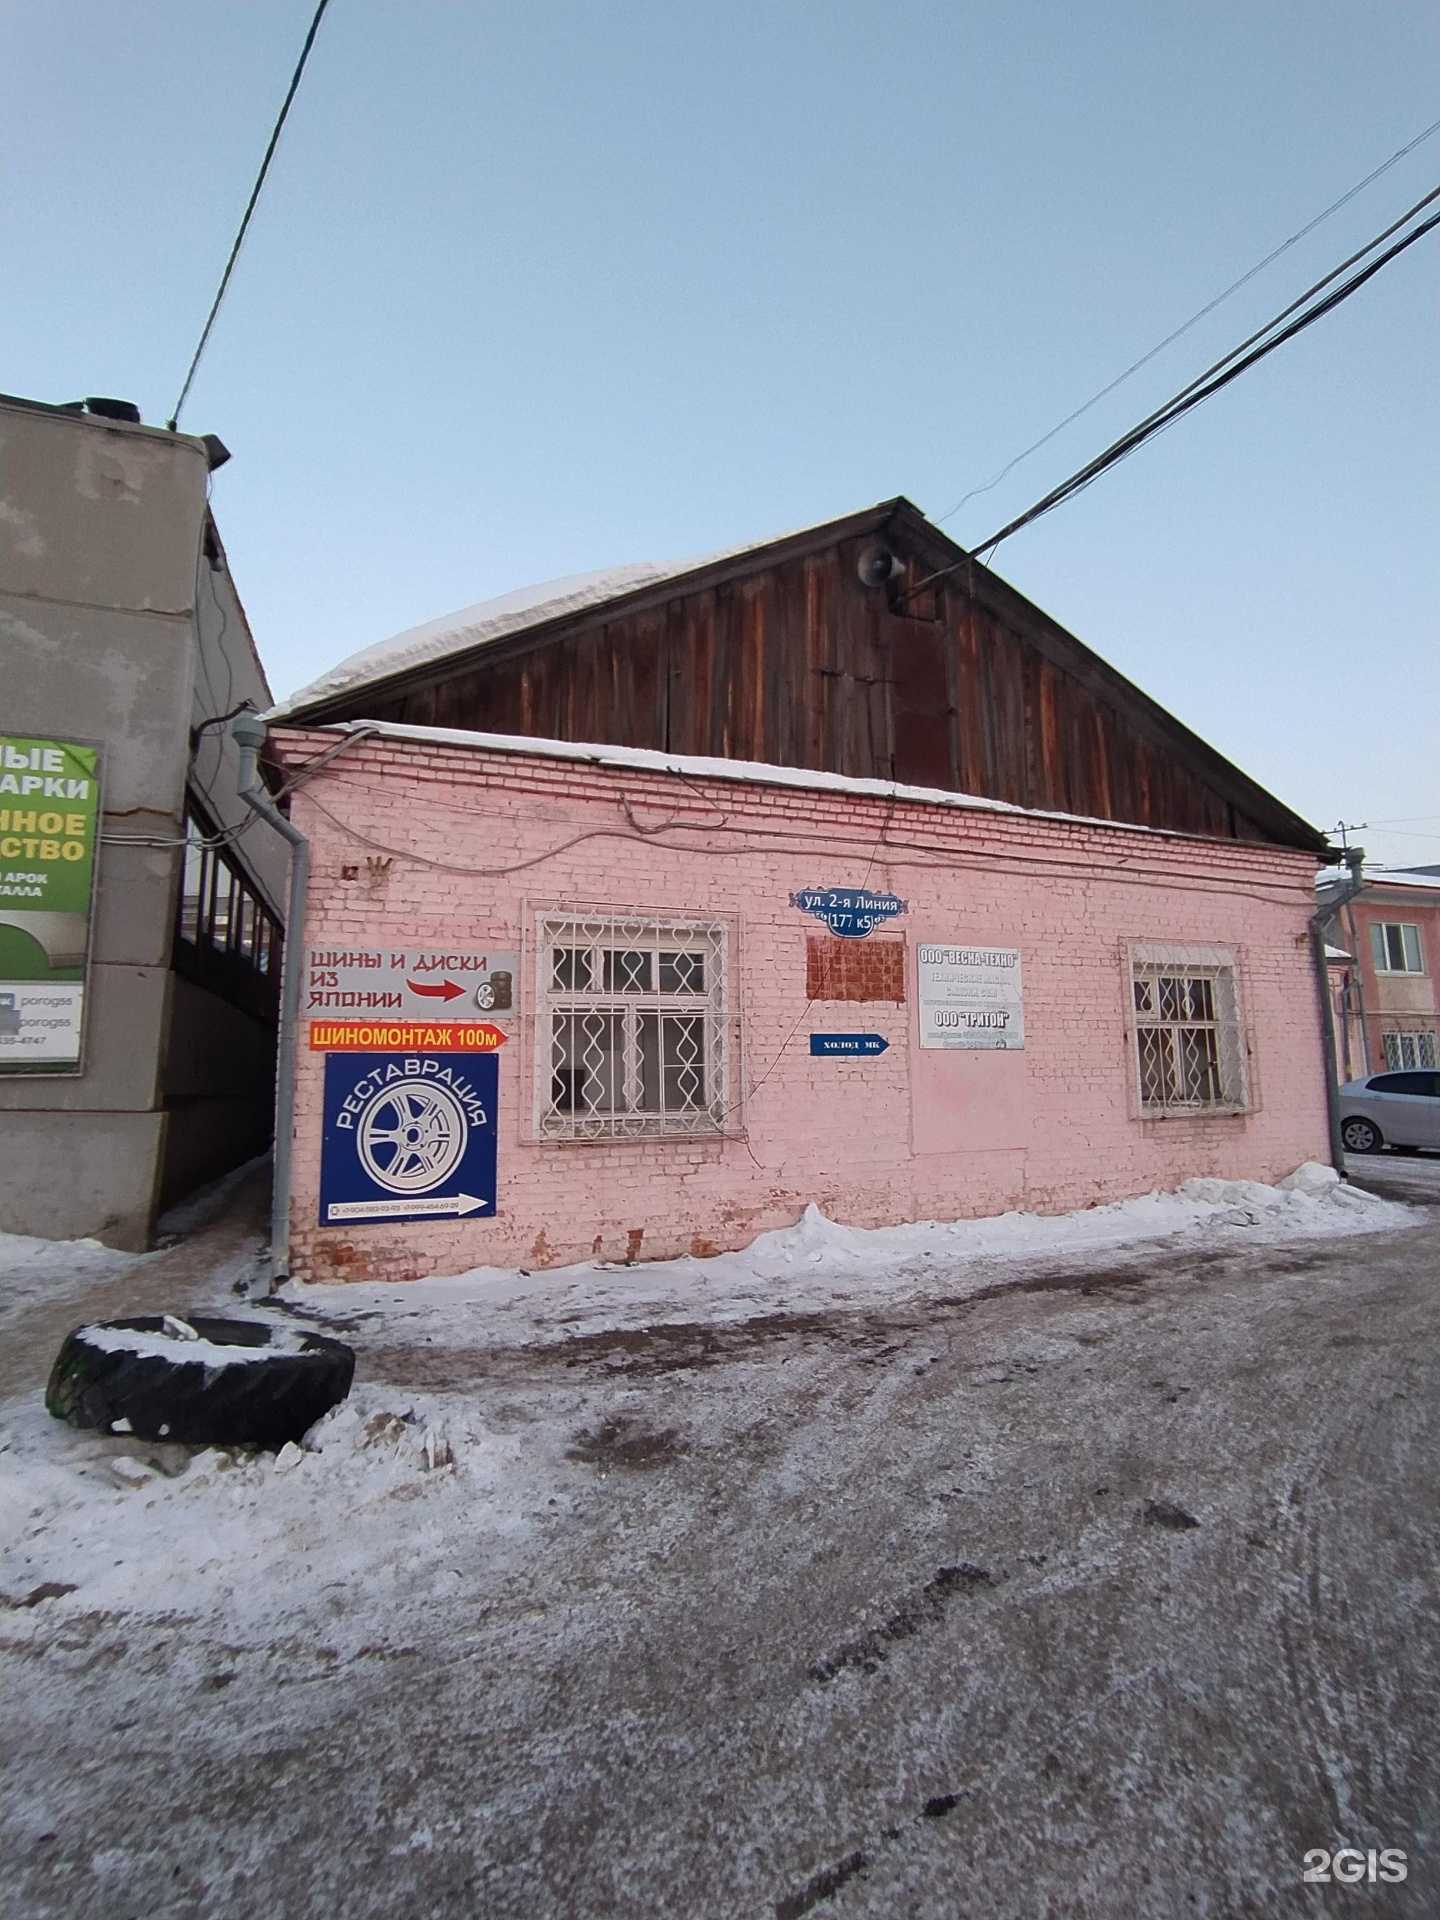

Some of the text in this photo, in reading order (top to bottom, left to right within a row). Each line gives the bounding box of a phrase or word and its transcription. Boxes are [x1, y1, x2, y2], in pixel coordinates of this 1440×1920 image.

[0, 745, 65, 772] ЫЕ
[0, 774, 89, 799] АРКИ
[0, 837, 85, 861] СТВО
[804, 894, 898, 911] ул. 2-я Линия
[832, 914, 871, 929] 177 к5
[310, 951, 488, 973] ШИНЫ И ДИСКИ
[310, 971, 339, 988] ИЗ
[306, 991, 403, 1009] ЯПОНИИ
[935, 1010, 959, 1028] ООО
[312, 1027, 497, 1046] ШИНОМОНТАЖ 100м
[336, 1059, 488, 1130] РЕСТАВРАЦИЯ
